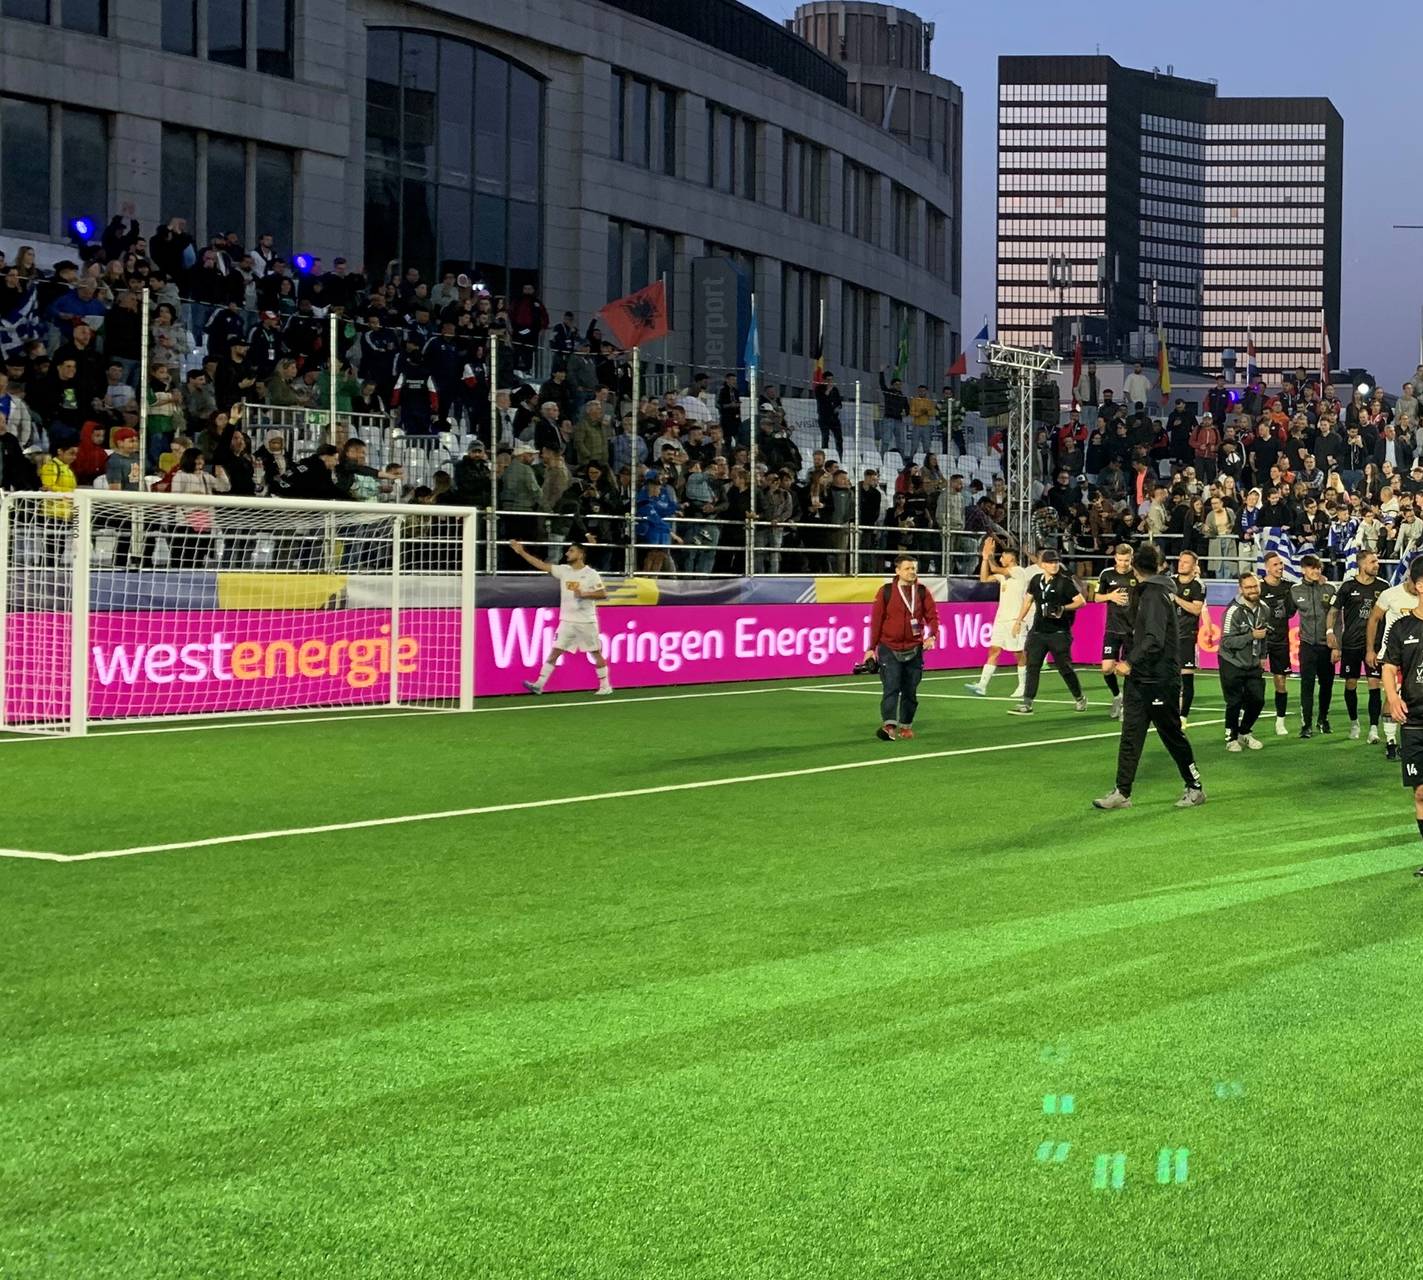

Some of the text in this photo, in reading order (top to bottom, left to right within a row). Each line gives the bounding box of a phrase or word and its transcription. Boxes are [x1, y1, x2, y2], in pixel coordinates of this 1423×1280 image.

[92, 624, 419, 689] westenergie
[735, 616, 855, 663] Energie
[1406, 763, 1418, 776] 14
